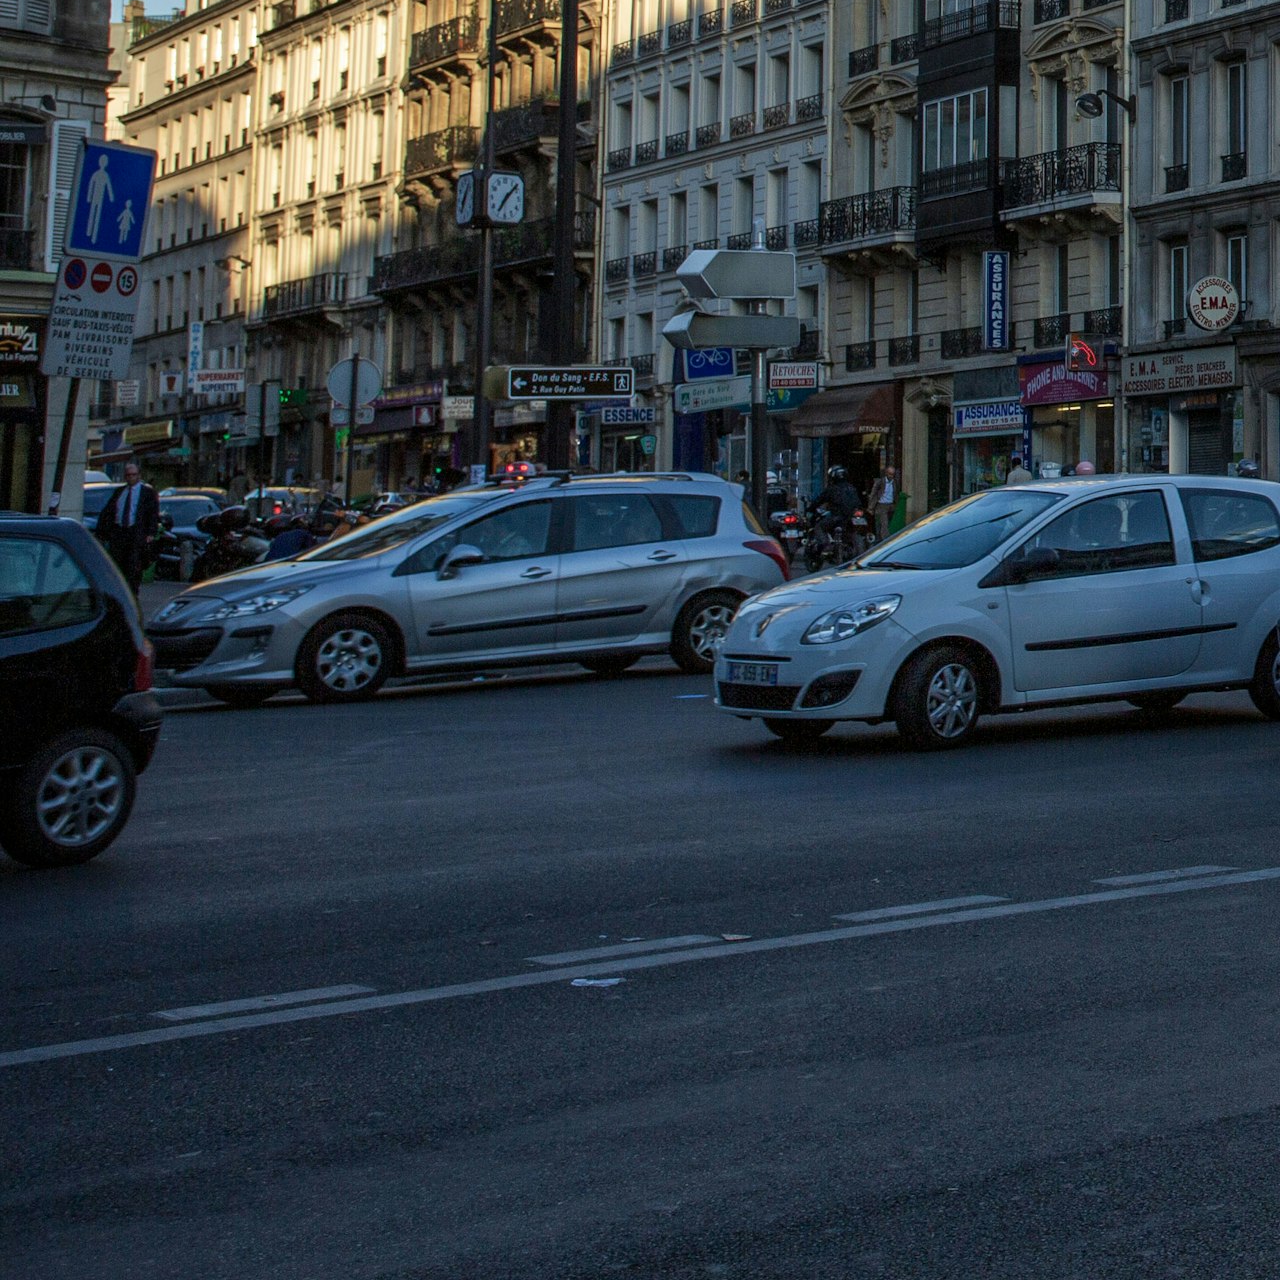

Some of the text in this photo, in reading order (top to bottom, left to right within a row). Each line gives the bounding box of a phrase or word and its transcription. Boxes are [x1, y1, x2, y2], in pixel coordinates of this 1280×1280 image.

[121, 273, 133, 289] 15
[1196, 278, 1233, 295] ACCESSOIRES
[991, 254, 1003, 348] ASSURANCES
[54, 306, 135, 322] CIRCULATION INTERDITE
[51, 318, 71, 328] SAUF
[22, 332, 38, 352] 21
[52, 329, 129, 345] PAM LIVRAISONS
[65, 343, 113, 356] RIVERAINS
[1162, 354, 1185, 365] SERVICE
[57, 366, 113, 379] DE SERVICE
[772, 364, 815, 377] RETOUCHES
[1130, 360, 1160, 377] E.M.A.
[1175, 361, 1226, 375] PIECES DETACHEES
[197, 372, 244, 382] SUPERMARKET
[532, 373, 548, 382] Don
[550, 373, 560, 382] du
[562, 373, 582, 383] Sang
[1027, 368, 1051, 398] PHONE
[1052, 364, 1066, 381] AND
[201, 383, 238, 392] SUPERETTE
[540, 385, 553, 393] Rue
[554, 385, 567, 394] Guy
[1124, 378, 1165, 393] ACCESSOIRES
[604, 408, 654, 422] ESSENCE
[964, 402, 1025, 420] ASSURANCES
